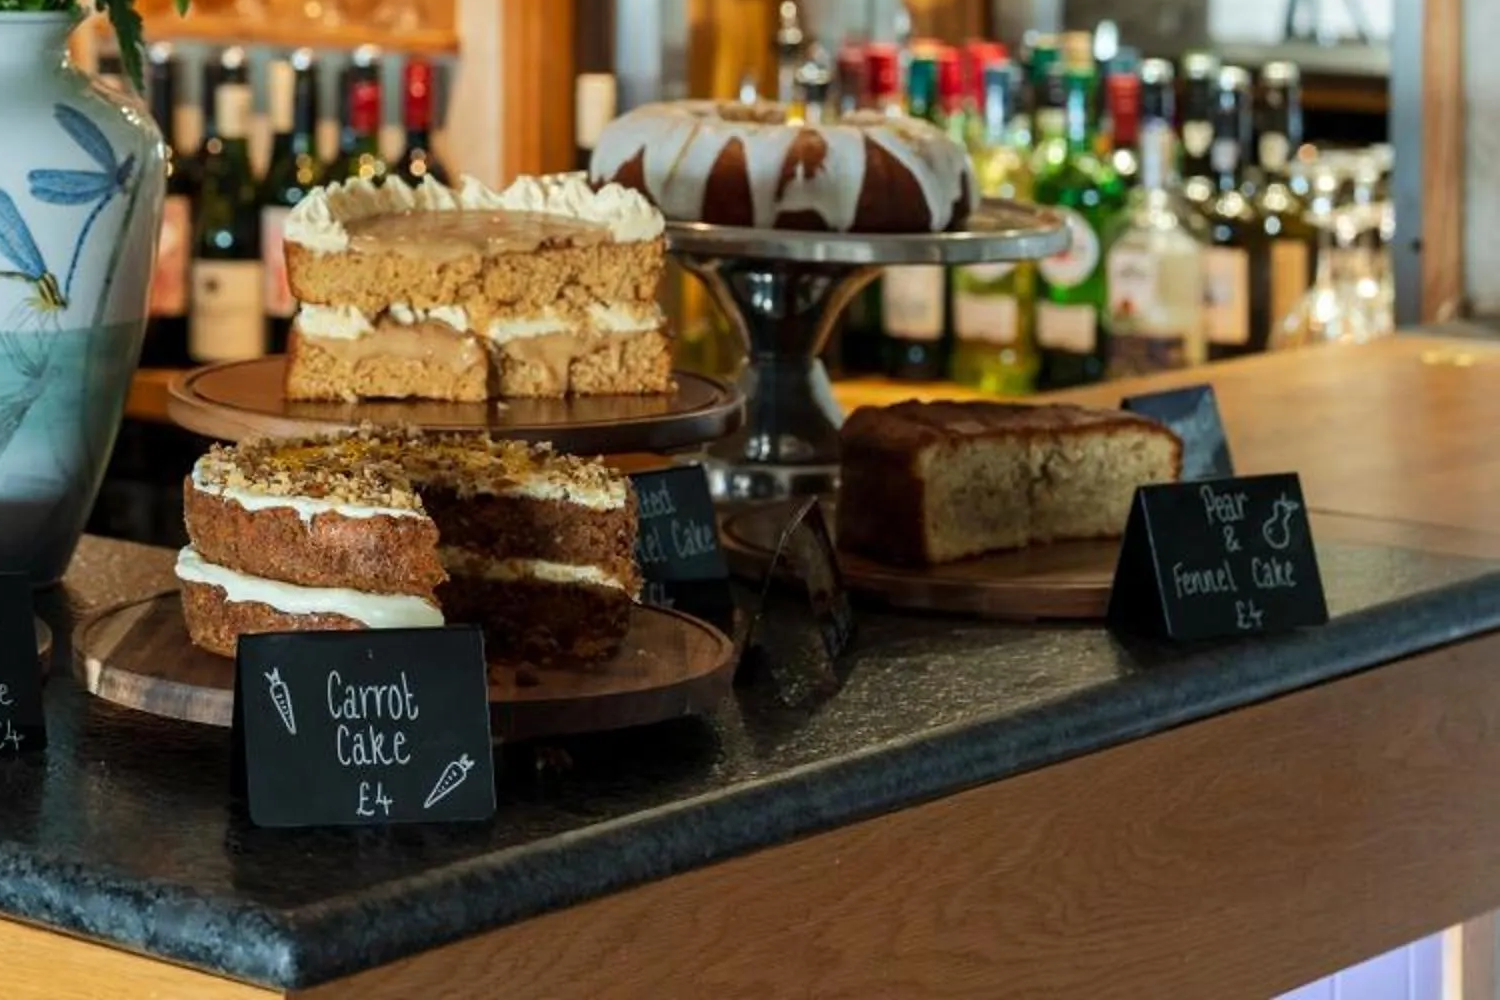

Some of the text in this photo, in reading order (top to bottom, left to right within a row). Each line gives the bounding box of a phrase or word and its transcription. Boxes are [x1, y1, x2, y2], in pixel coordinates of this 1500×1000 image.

[1200, 484, 1249, 525] Pear
[1222, 524, 1244, 552] &
[1172, 556, 1298, 600] Fennel Cake
[1234, 598, 1265, 630] £4
[327, 669, 420, 721] Carrot
[336, 723, 412, 766] Cake
[355, 780, 394, 817] £4
